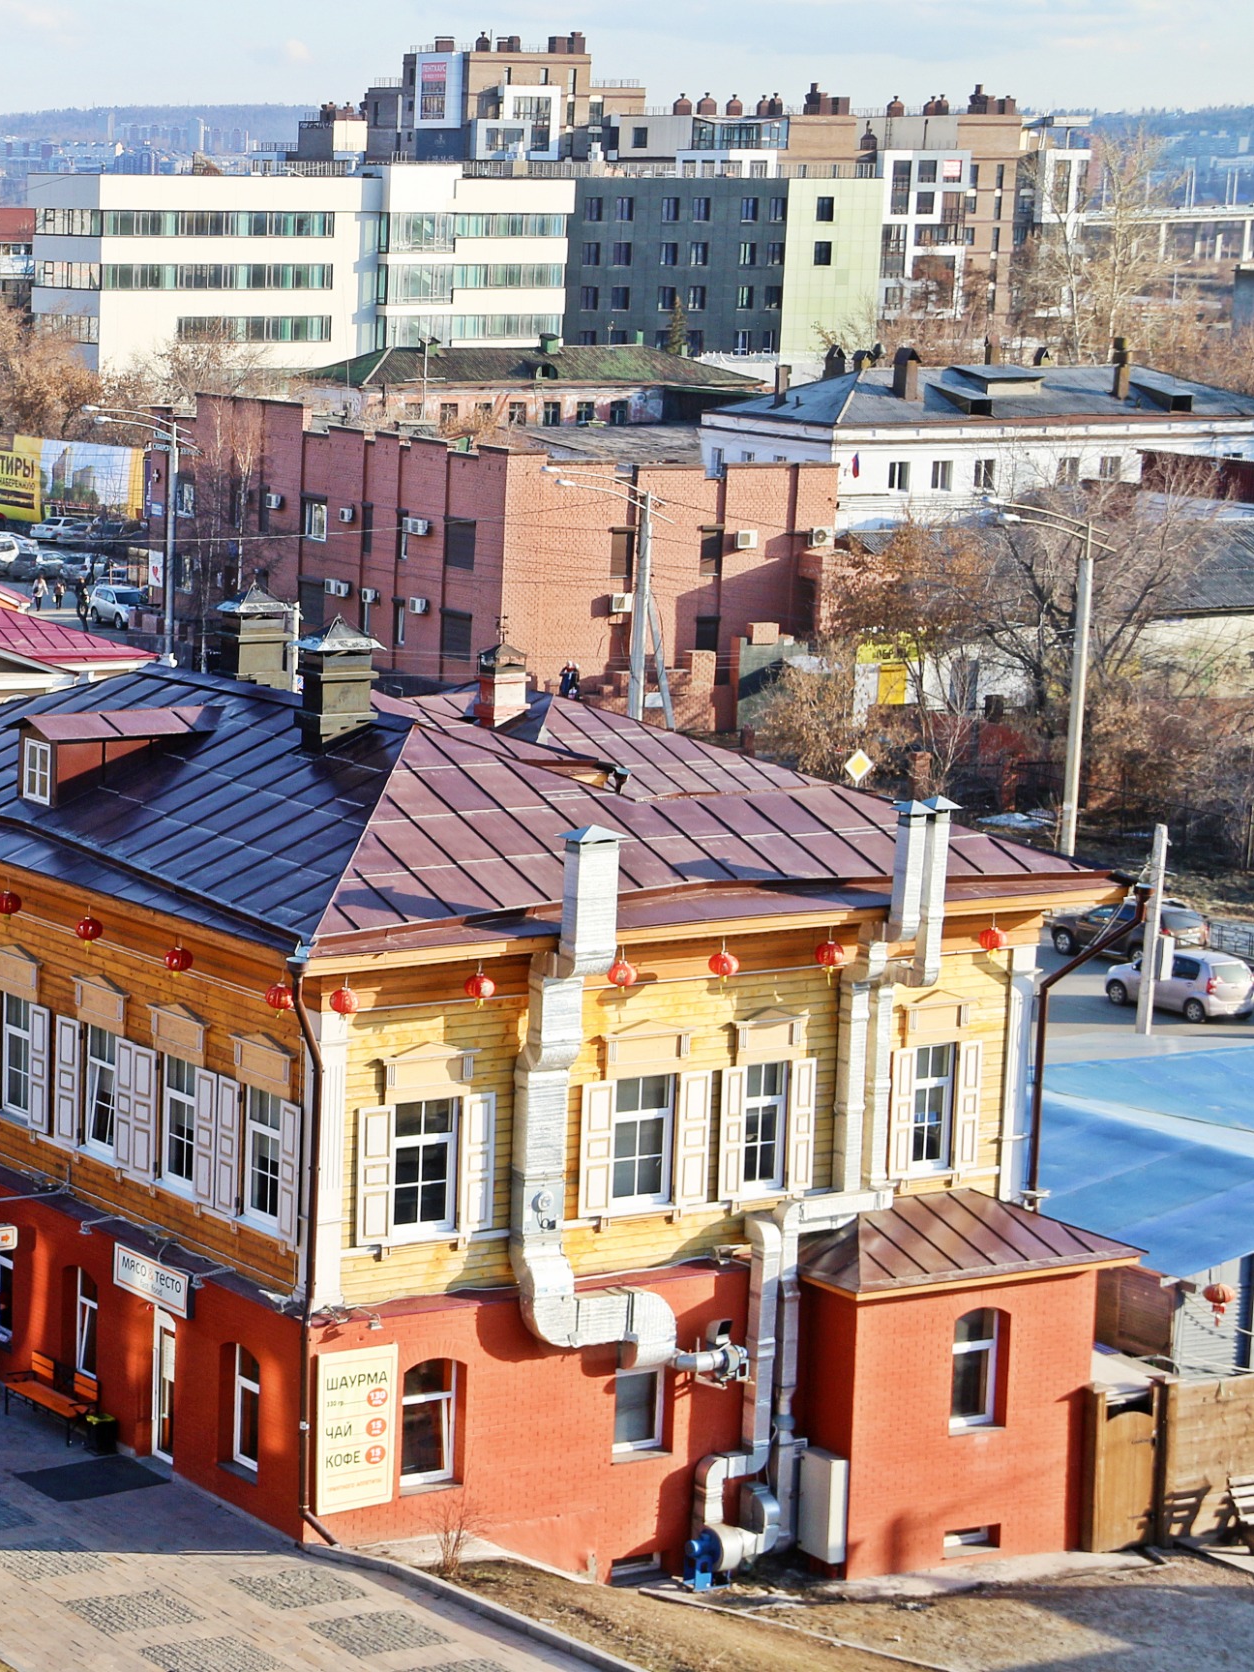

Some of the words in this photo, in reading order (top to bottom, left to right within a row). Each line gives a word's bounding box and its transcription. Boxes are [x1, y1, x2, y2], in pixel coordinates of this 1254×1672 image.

[326, 1370, 388, 1391] ШАУРМА
[325, 1421, 352, 1439] ЧАЙ
[371, 1420, 382, 1429] 15
[325, 1450, 361, 1469] КОФЕ
[370, 1448, 382, 1457] 15
